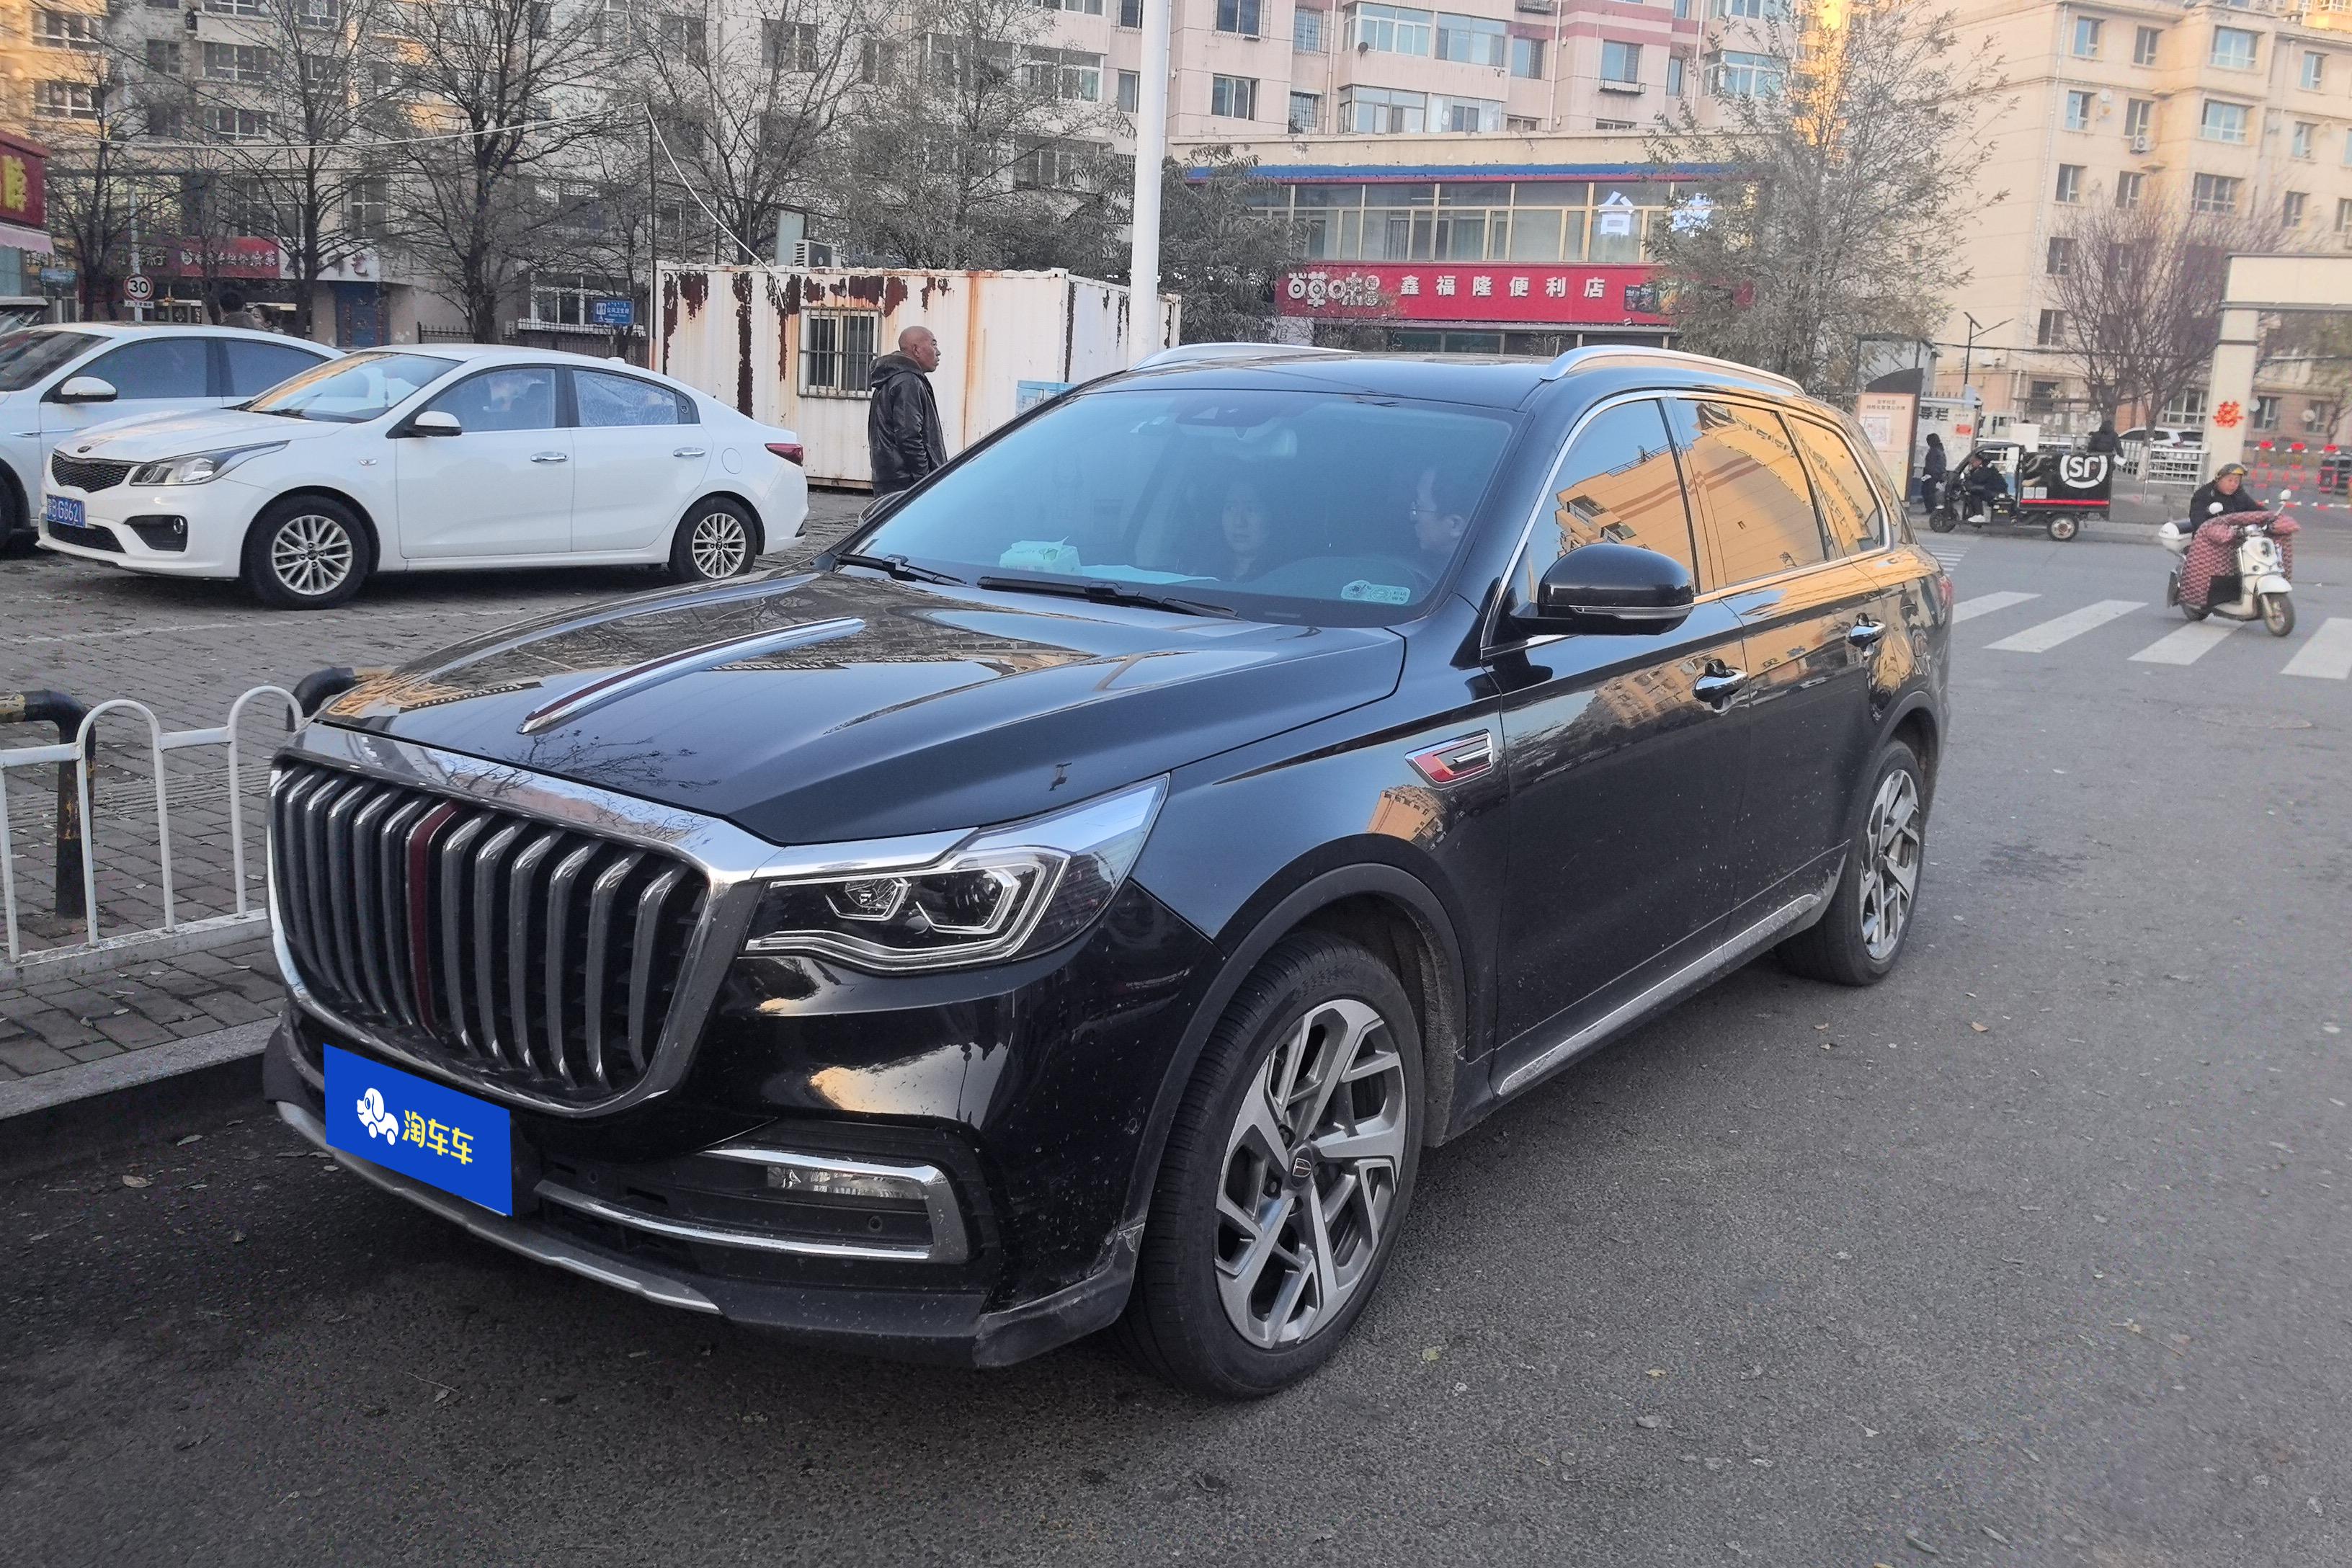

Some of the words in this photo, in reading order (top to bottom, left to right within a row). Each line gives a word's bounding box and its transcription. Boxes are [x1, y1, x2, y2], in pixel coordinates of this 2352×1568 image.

[129, 280, 148, 294] 30
[1401, 275, 1605, 298] 鑫福隆便利店
